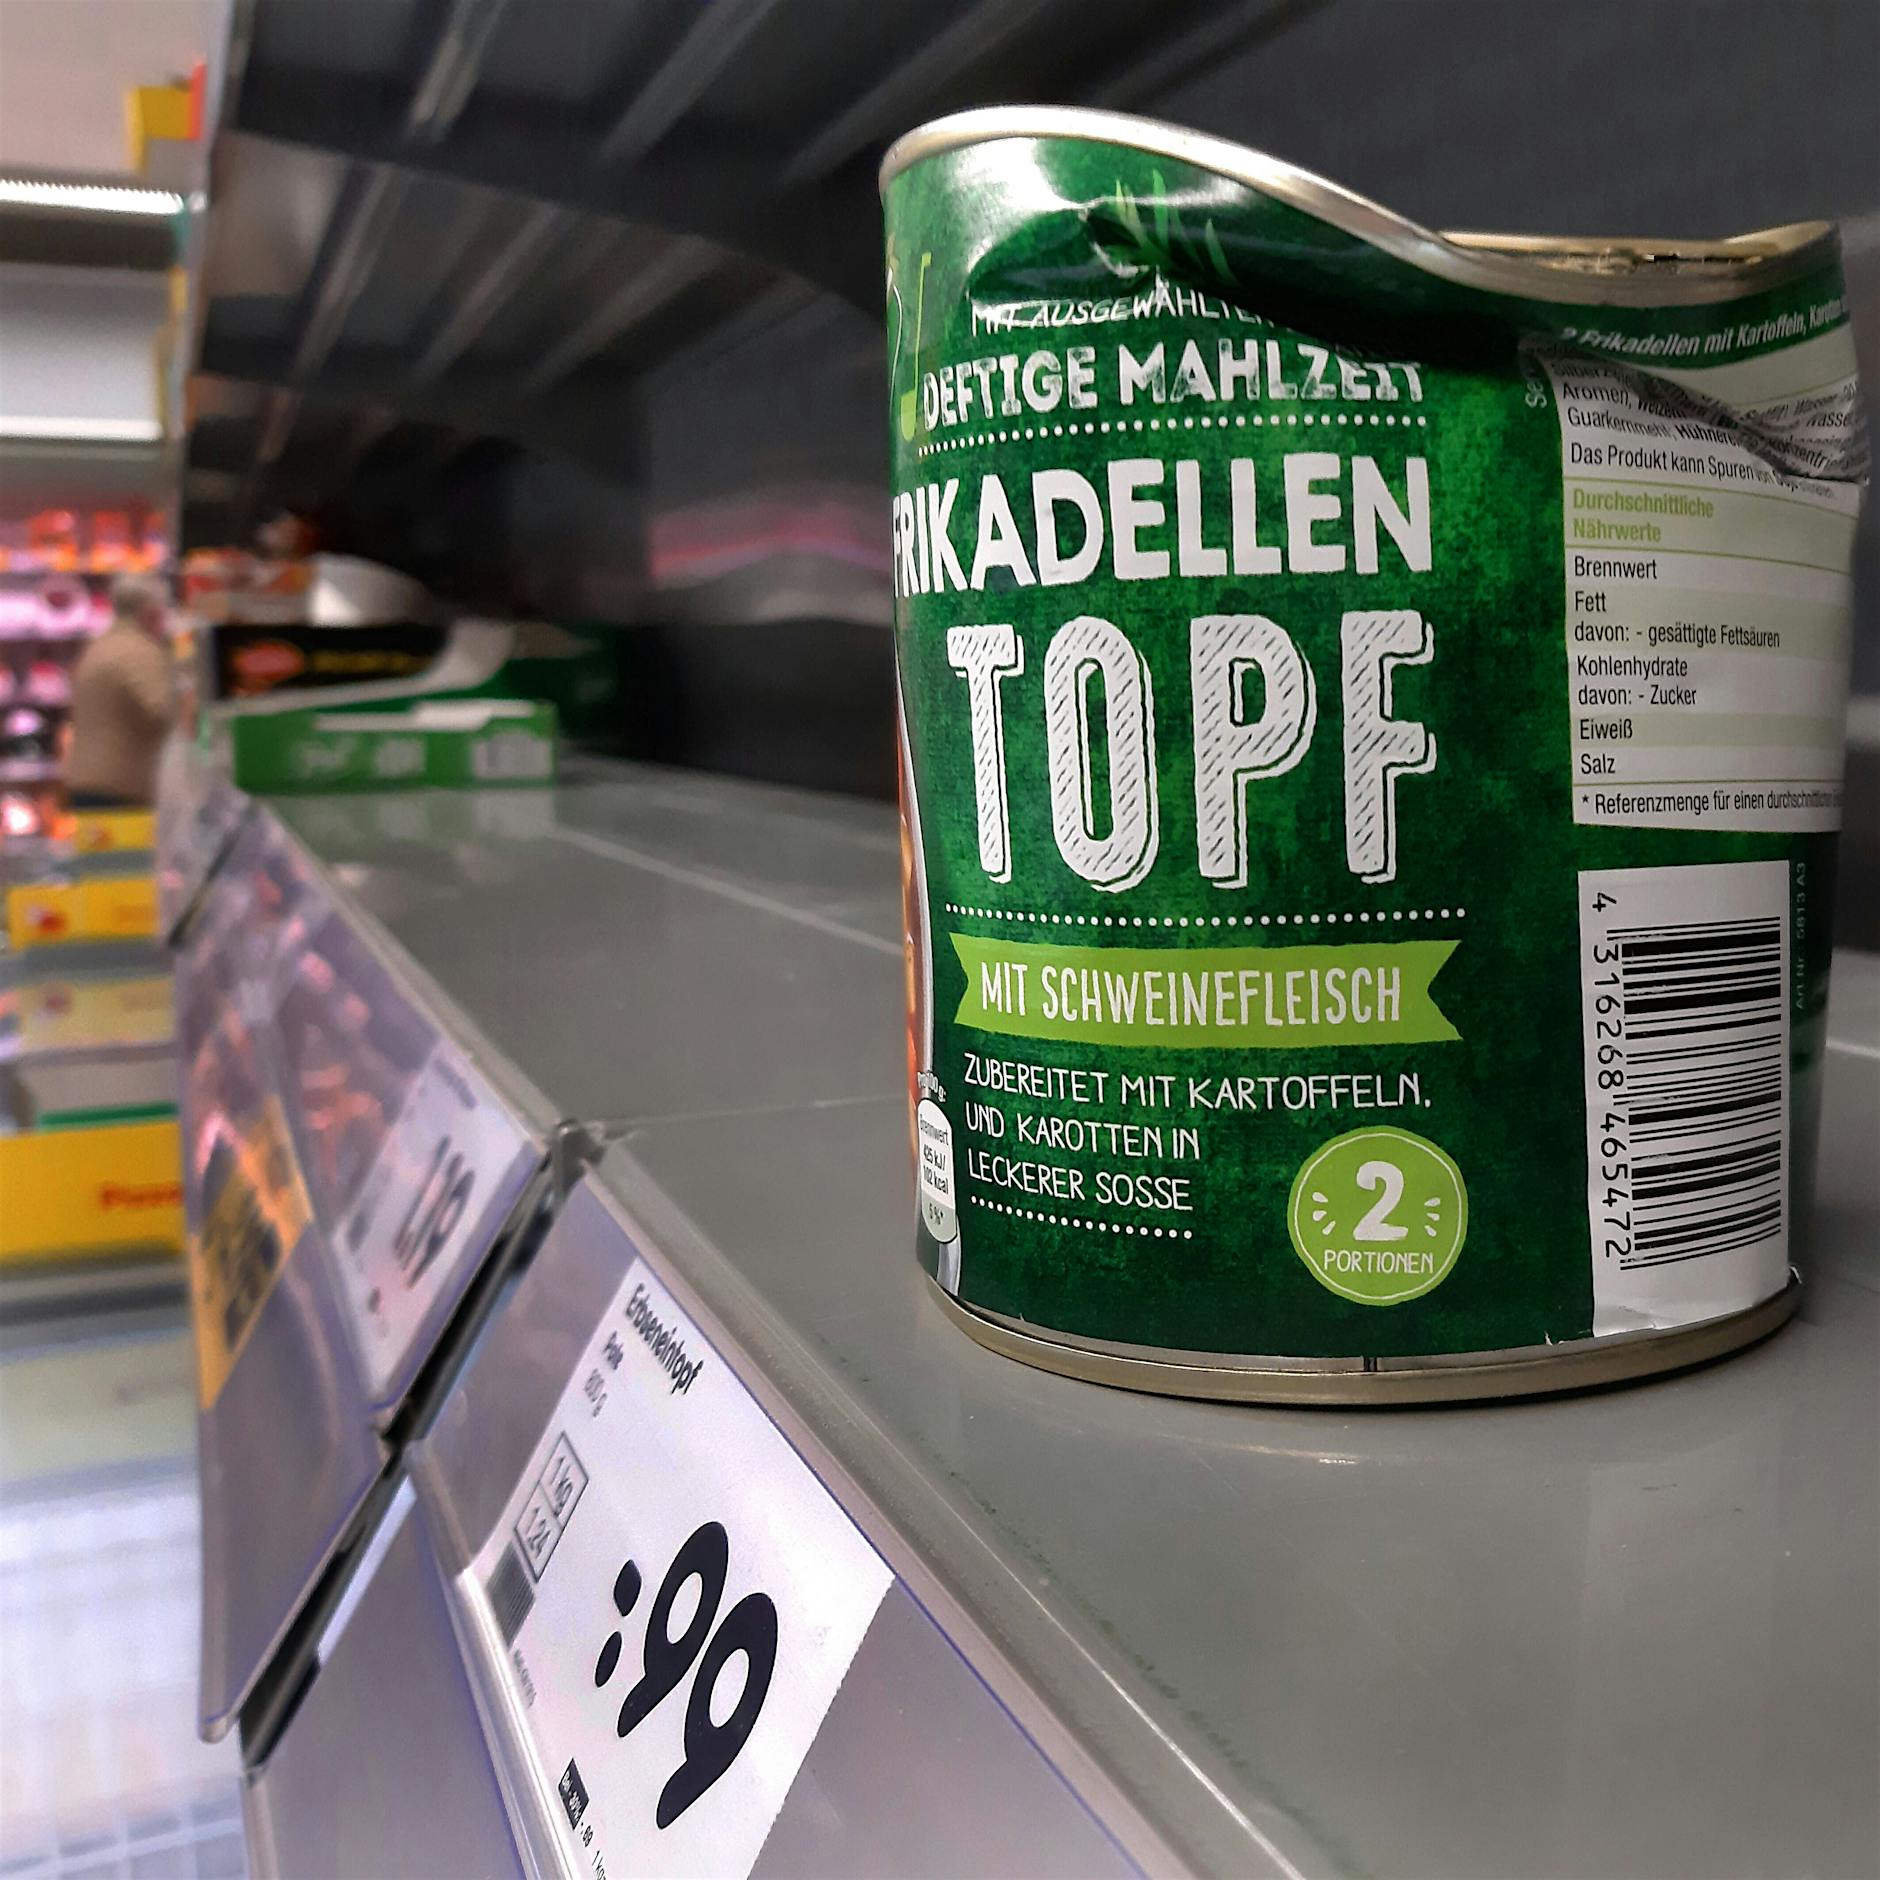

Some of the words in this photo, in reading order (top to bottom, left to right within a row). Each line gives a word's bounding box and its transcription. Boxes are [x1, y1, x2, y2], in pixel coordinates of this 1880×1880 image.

[1579, 328, 1700, 356] Frikadellen
[1704, 330, 1732, 354] mit
[1736, 313, 1806, 347] Kartoffeln,
[924, 345, 1098, 431] DEFTIGE
[1118, 338, 1424, 403] MAHLZEIT
[1562, 381, 1632, 409] Aromen,
[1568, 406, 1677, 440] Guarkernmehl,
[1570, 442, 1603, 465] Das
[1607, 445, 1668, 472] Produkt
[1672, 452, 1705, 475] kann
[1708, 455, 1754, 481] Spuren
[1572, 488, 1715, 519] Durchschnittliche
[893, 452, 1433, 599] FRIKADELLEN
[1572, 517, 1662, 543] Nährwerte
[1574, 555, 1658, 579] Brennwert
[1575, 590, 1607, 612] Fett
[1574, 620, 1629, 642] davon:
[1648, 621, 1717, 648] gesättigte
[1720, 624, 1780, 648] Fettsäuren
[1577, 655, 1688, 681] Kohlenhydrate
[1578, 684, 1632, 705] davon:
[1650, 684, 1697, 705] Zucker
[1579, 718, 1634, 740] Eiweiß
[946, 609, 1437, 893] TOPF
[1580, 753, 1616, 774] Salz
[1595, 789, 1710, 816] Referenzmenge
[1713, 790, 1730, 810] für
[1733, 790, 1764, 810] einen
[980, 961, 1028, 1015] MIT
[1041, 964, 1402, 1027] SCHWEINEFLEISCH
[964, 1052, 1110, 1103] ZUBEREITET
[1121, 1074, 1176, 1108] MIT
[965, 1101, 1005, 1138] UND
[1017, 1112, 1164, 1158] KAROTTEN
[1172, 1127, 1201, 1161] IN
[933, 1172, 949, 1195] kcal
[967, 1148, 1086, 1201] LECKERER
[1095, 1171, 1194, 1211] SOSSE
[1352, 1159, 1409, 1242] 2
[1323, 1248, 1434, 1274] PORTIONEN
[625, 1282, 705, 1396] Erbseneintopf
[554, 1464, 573, 1518] kg
